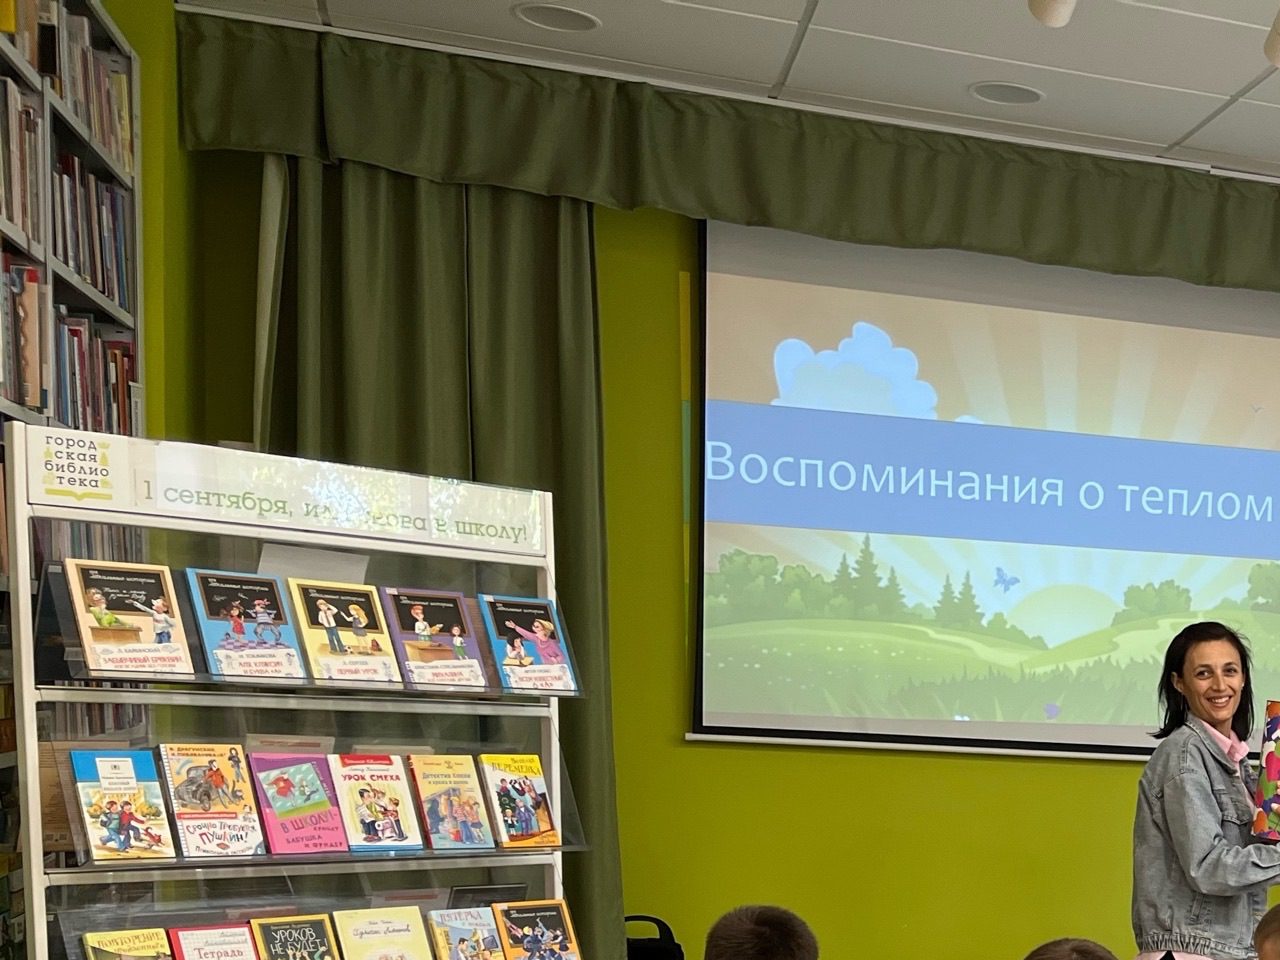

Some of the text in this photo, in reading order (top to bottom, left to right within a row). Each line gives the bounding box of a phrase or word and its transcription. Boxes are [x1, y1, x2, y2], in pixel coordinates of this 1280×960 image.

[45, 435, 97, 451] город
[55, 450, 98, 463] ская
[44, 460, 109, 477] библио
[56, 475, 99, 488] тека
[705, 440, 1065, 508] Воспоминания
[1079, 480, 1105, 510] о
[1119, 481, 1275, 524] теплом
[144, 480, 154, 500] 1
[163, 485, 294, 518] сентября,
[455, 520, 528, 544] школу!
[271, 927, 316, 943] УРОКОВ
[193, 947, 244, 960] Тетрадь
[270, 938, 329, 956] НЕ БУДЕТ!
